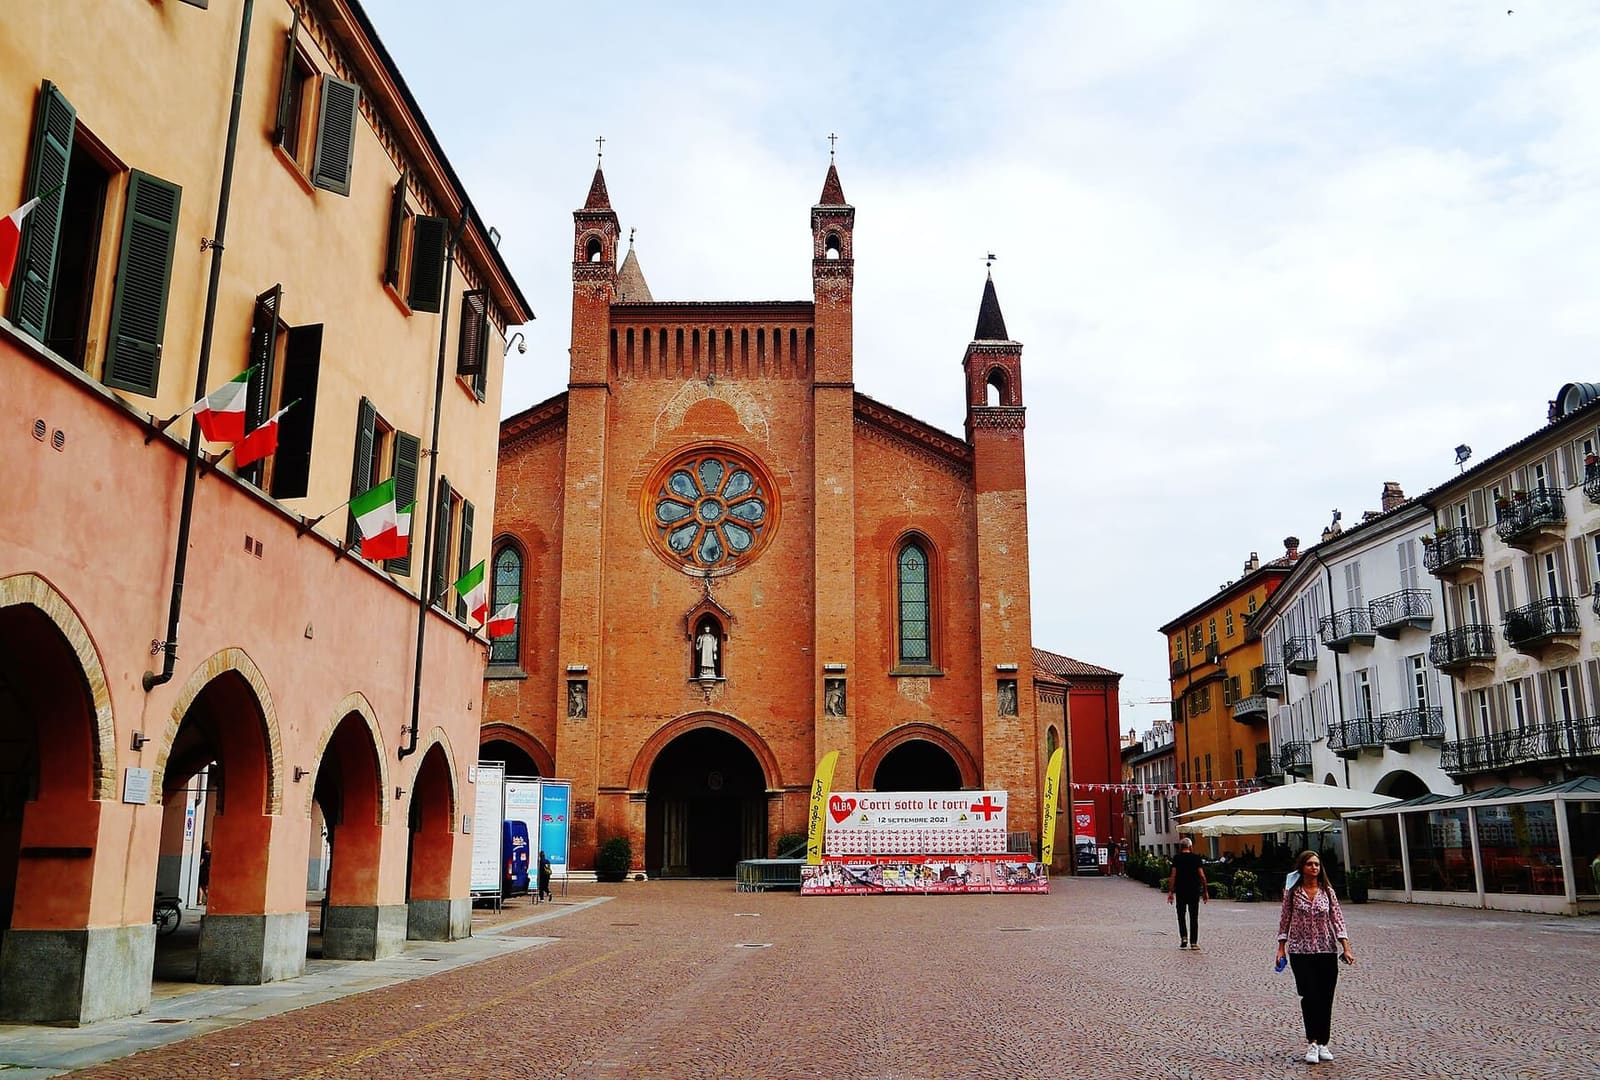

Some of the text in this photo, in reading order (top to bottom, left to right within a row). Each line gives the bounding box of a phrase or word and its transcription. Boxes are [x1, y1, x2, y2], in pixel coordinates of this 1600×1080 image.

[1045, 777, 1054, 800] Sport
[808, 779, 823, 841] Triangolo Sport
[832, 802, 852, 811] ALBA
[859, 798, 968, 810] Corri sotto le torri
